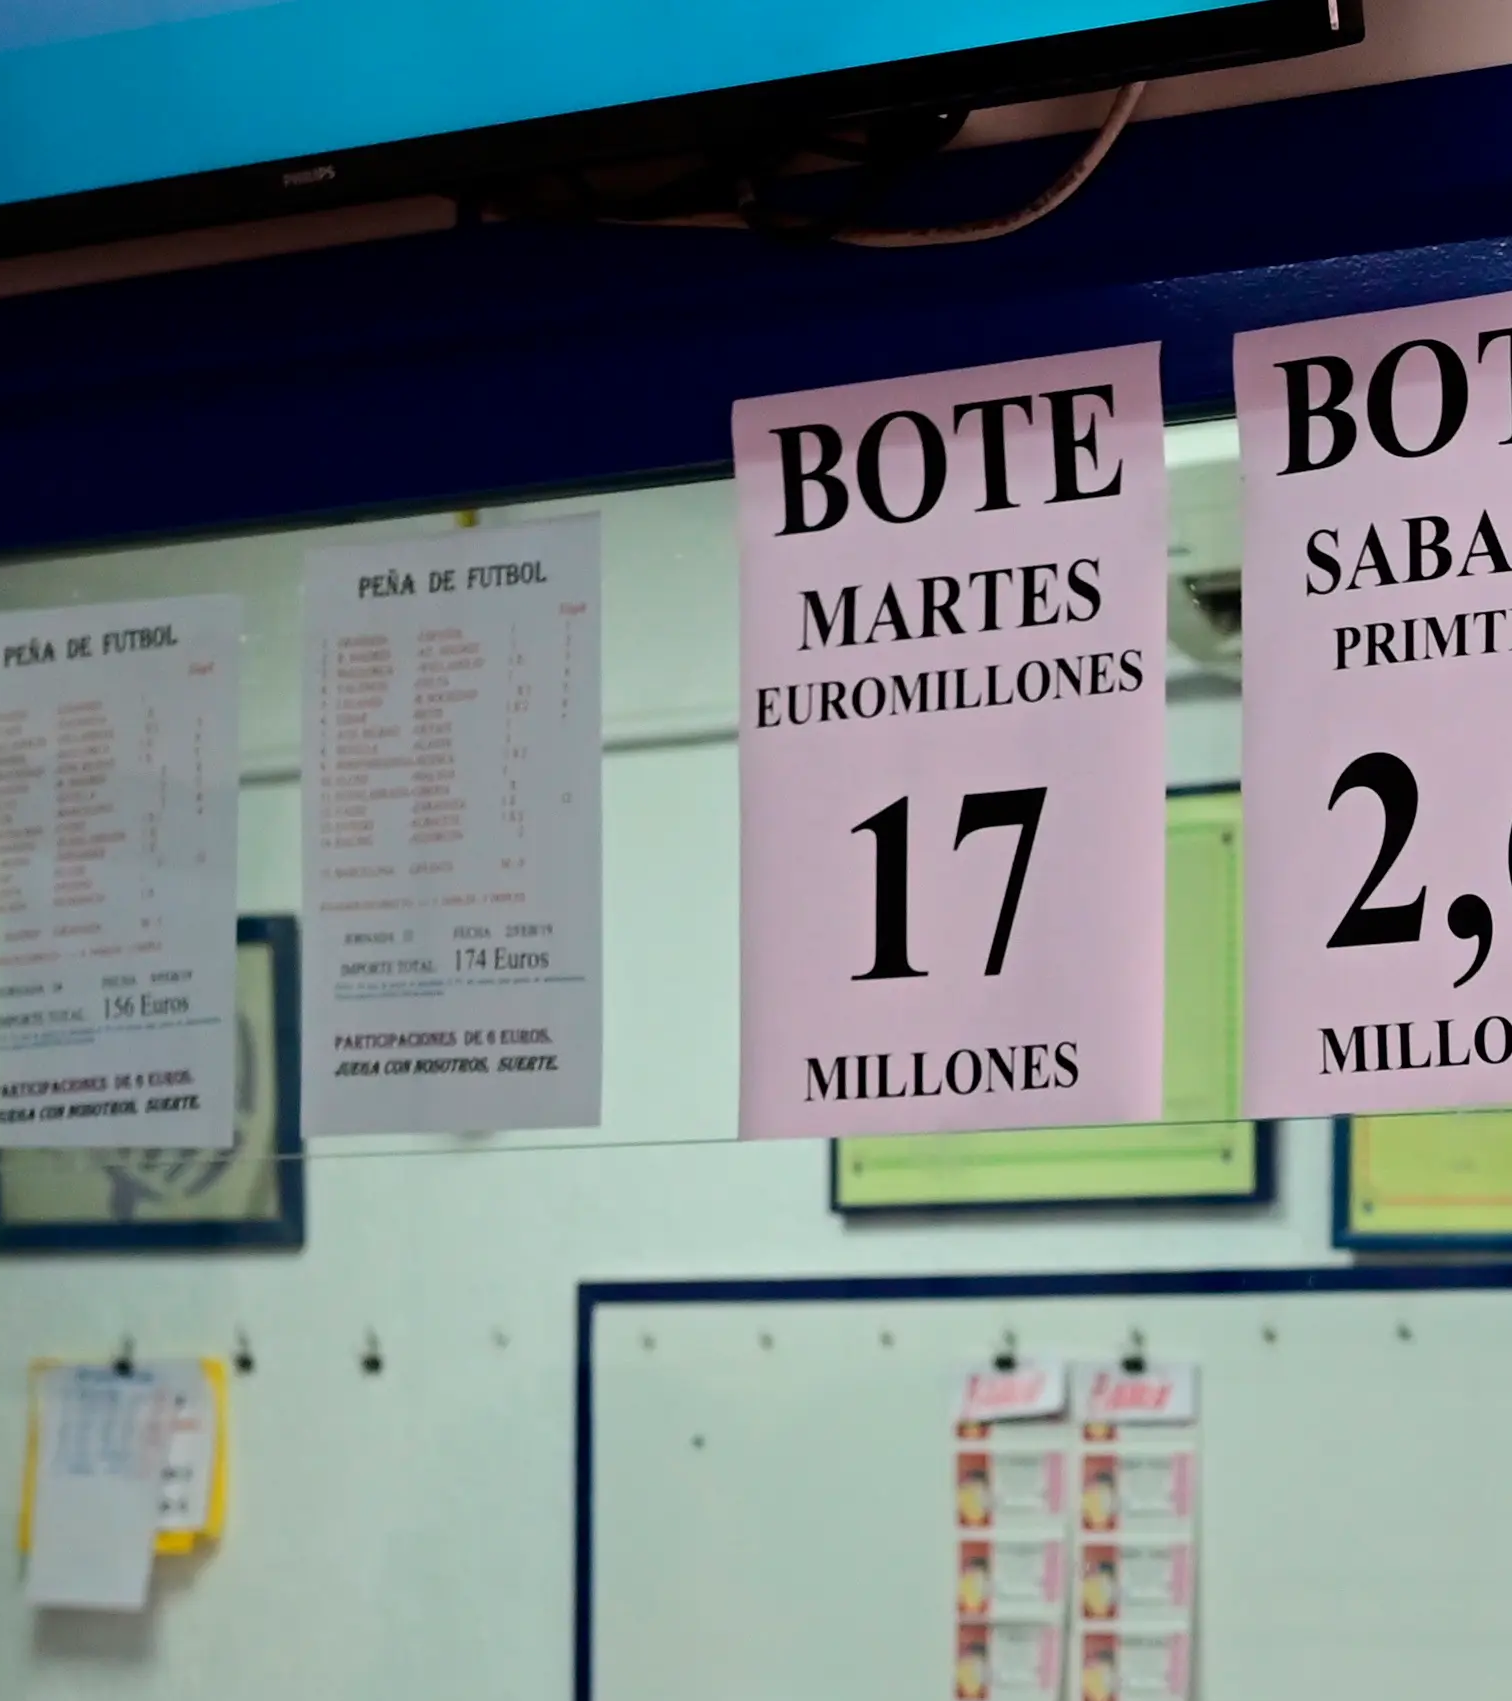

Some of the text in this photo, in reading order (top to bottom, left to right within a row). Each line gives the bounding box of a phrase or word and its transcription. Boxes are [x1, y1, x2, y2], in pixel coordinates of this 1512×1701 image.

[770, 384, 1124, 537] BOTE
[797, 558, 1102, 651] MARTES
[755, 649, 1144, 728] EUROMILLONES
[849, 786, 1048, 981] 17
[804, 1041, 1079, 1102] MILLONES
